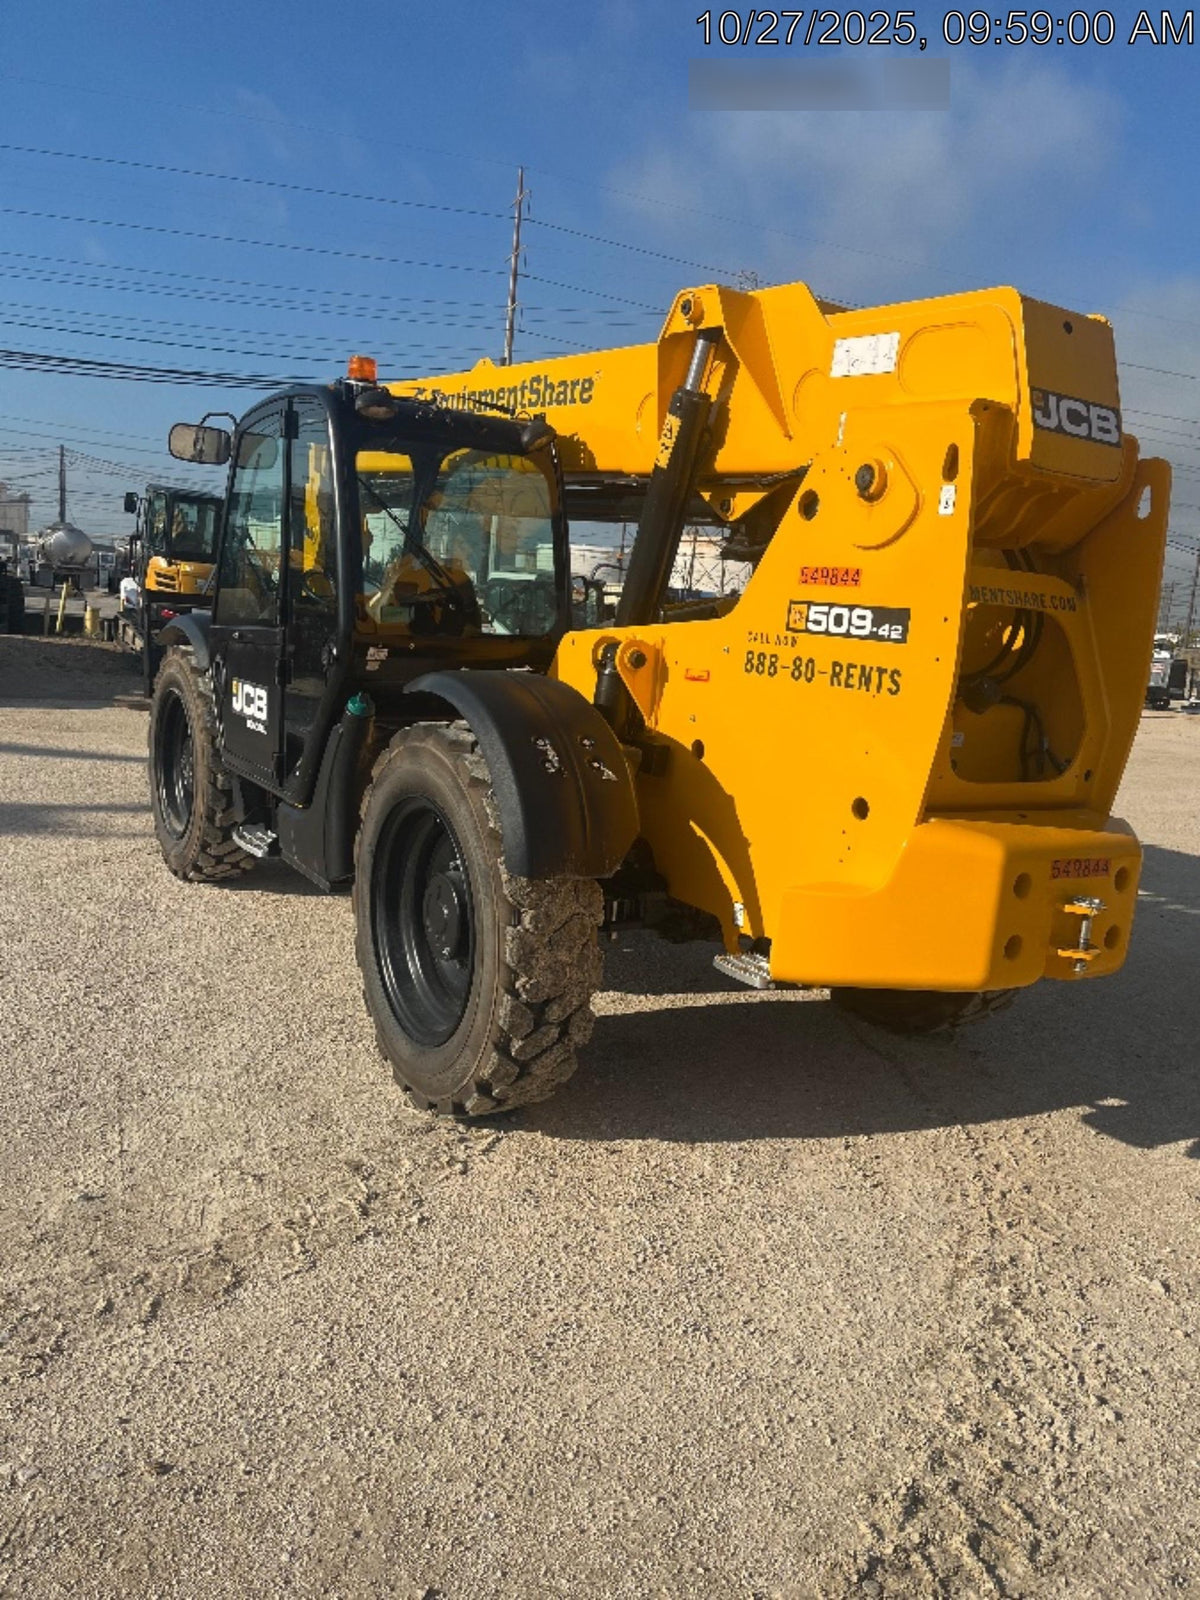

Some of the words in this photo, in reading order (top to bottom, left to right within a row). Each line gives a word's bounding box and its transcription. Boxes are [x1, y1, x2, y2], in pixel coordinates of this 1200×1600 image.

[1034, 395, 1120, 443] JCB
[801, 566, 861, 586] 549844
[744, 650, 902, 696] 888-80-RENTS
[232, 680, 268, 721] JCB
